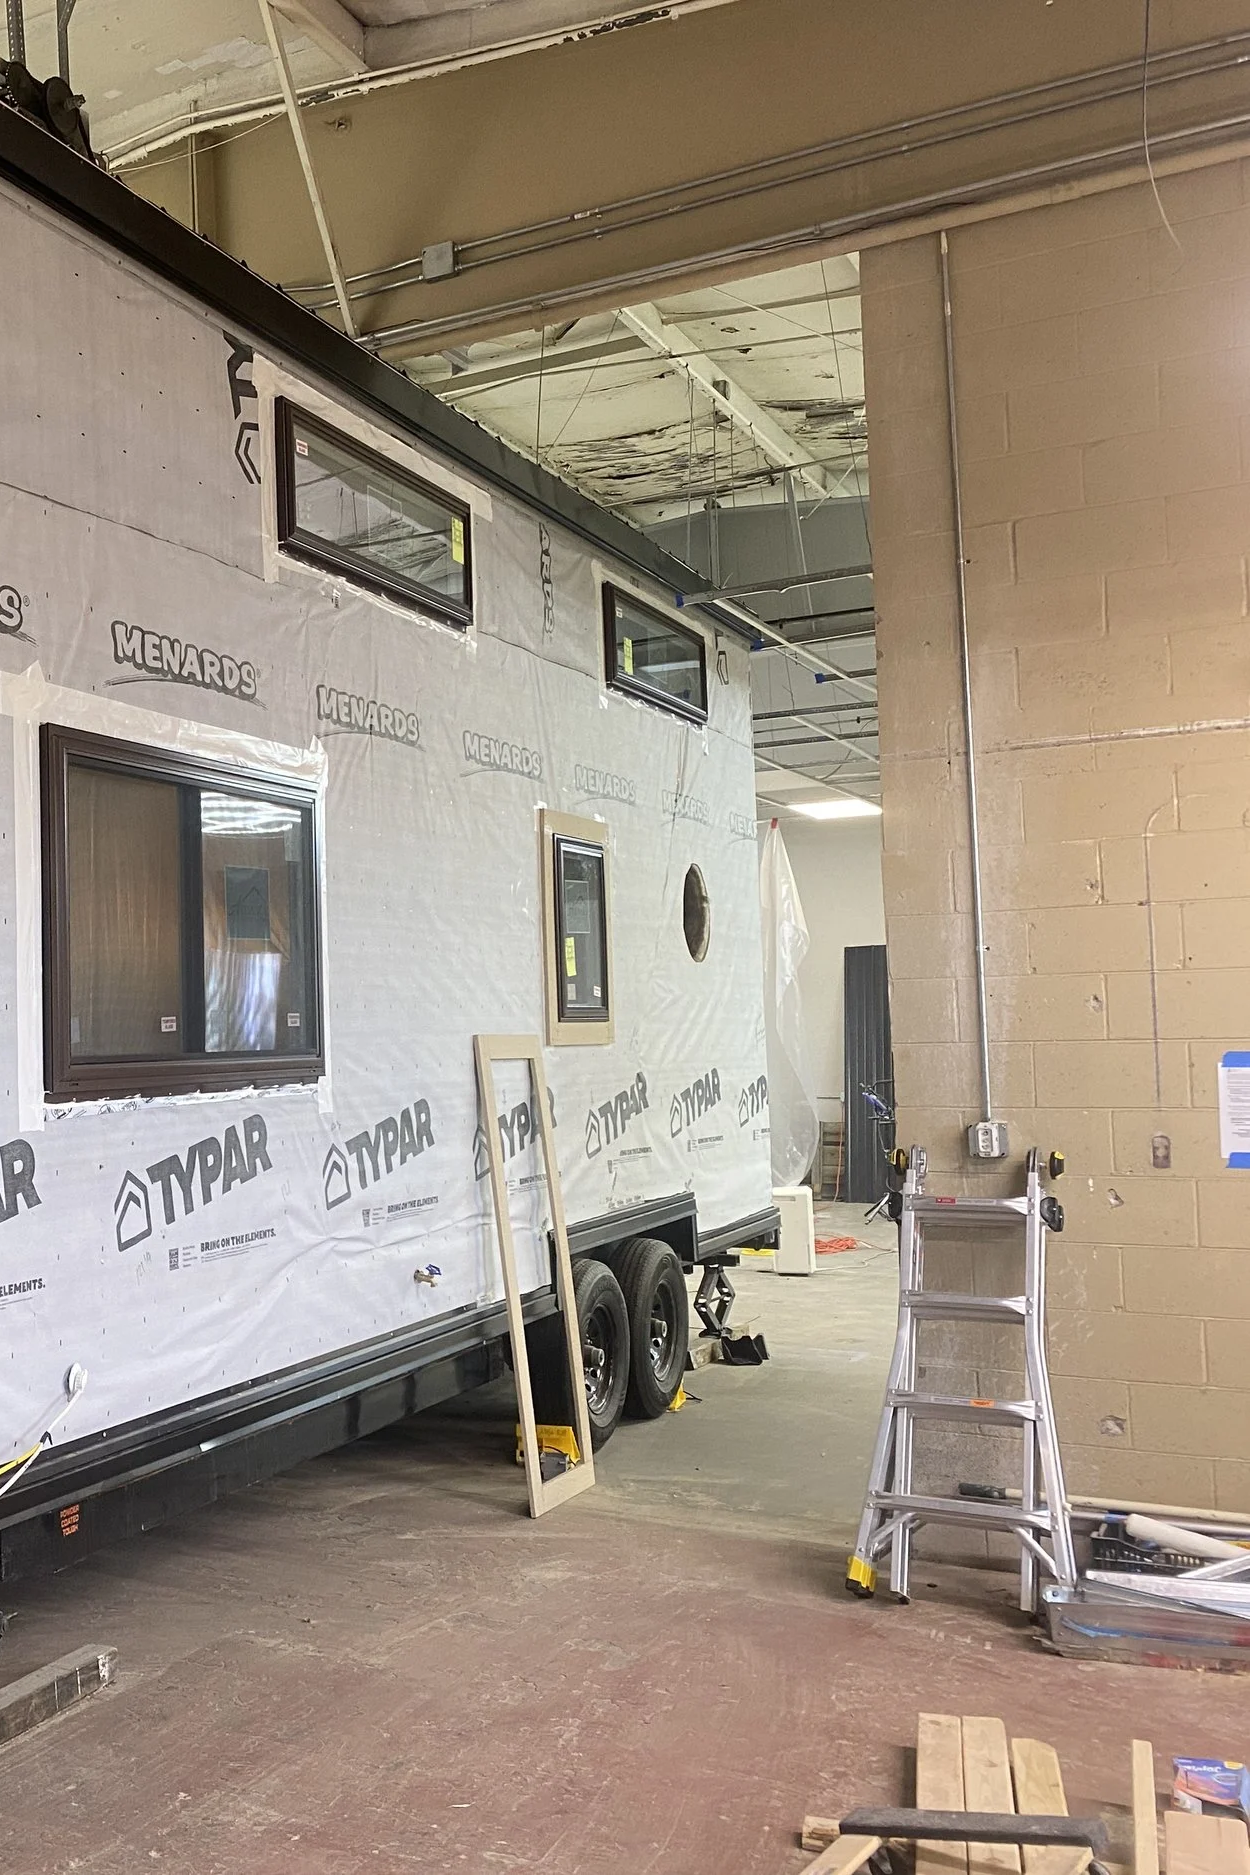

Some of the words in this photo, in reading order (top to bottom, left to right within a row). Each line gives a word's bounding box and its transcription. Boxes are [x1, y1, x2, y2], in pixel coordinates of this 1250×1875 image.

[110, 621, 259, 699] MENARDS
[316, 685, 419, 745] MENARDS
[462, 730, 542, 778] MENARDS
[574, 764, 636, 802] MENARDS
[599, 1071, 649, 1145] TYPAR
[681, 1068, 721, 1127] TYPAR
[146, 1114, 272, 1225] TYPAR
[345, 1098, 435, 1189] TYPAR
[201, 1240, 220, 1252] BRING
[221, 1237, 230, 1247] ON
[231, 1235, 244, 1246] THE
